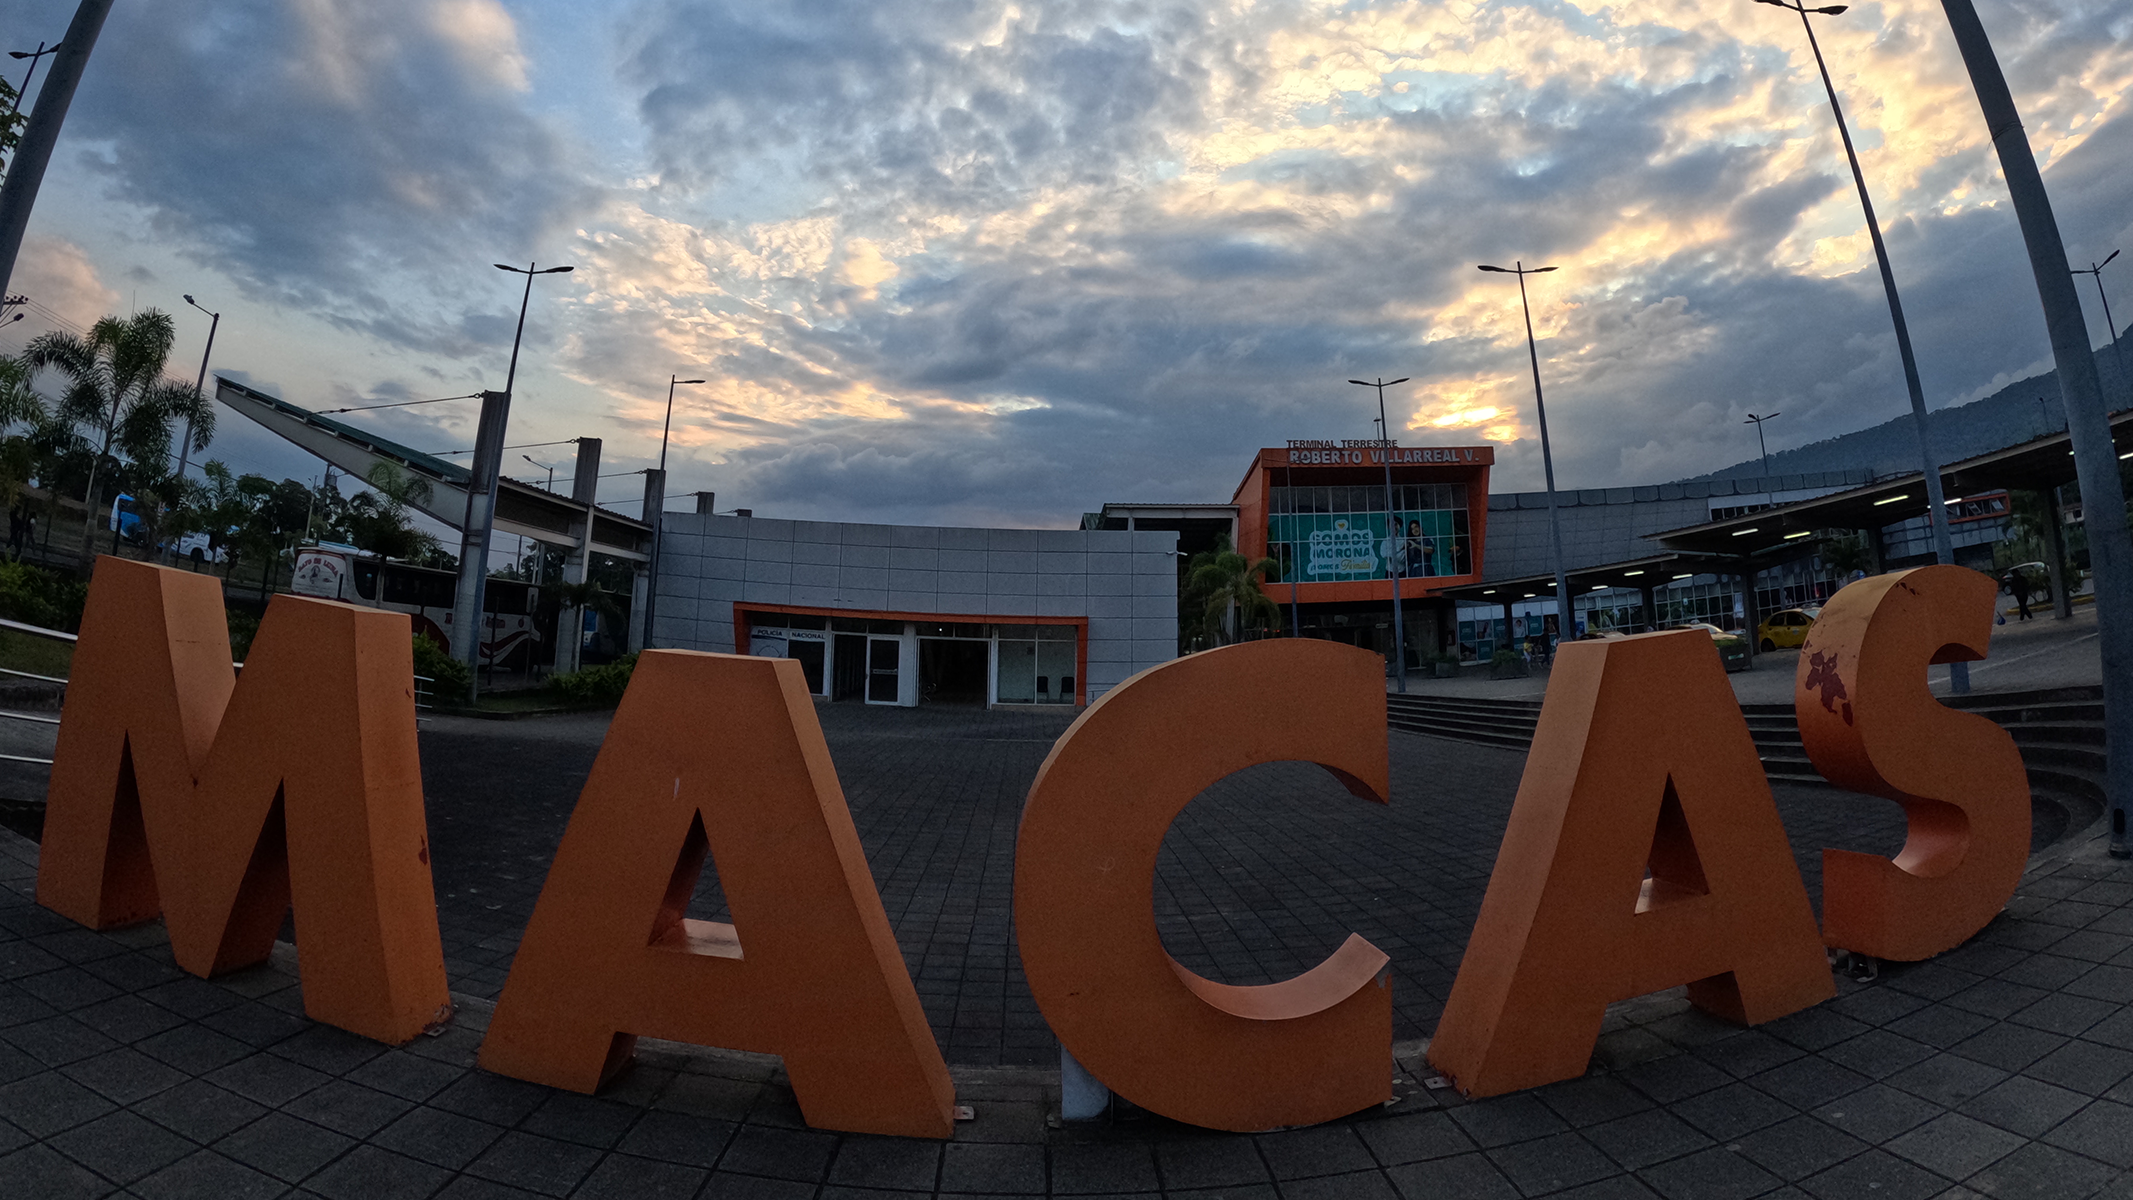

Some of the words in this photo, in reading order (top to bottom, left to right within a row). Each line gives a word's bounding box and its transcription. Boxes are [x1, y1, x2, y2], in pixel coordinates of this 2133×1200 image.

[1286, 439, 1337, 448] TERMINAL
[1340, 439, 1398, 448] TERRESTRE
[1289, 450, 1362, 464] ROBERTO
[1370, 449, 1461, 463] VILLARREAL
[1463, 448, 1479, 462] V.
[1312, 532, 1370, 546] SOMOS
[1313, 547, 1370, 559] MORONA
[791, 631, 825, 640] NACIONAL
[36, 554, 2033, 1139] MACAS
